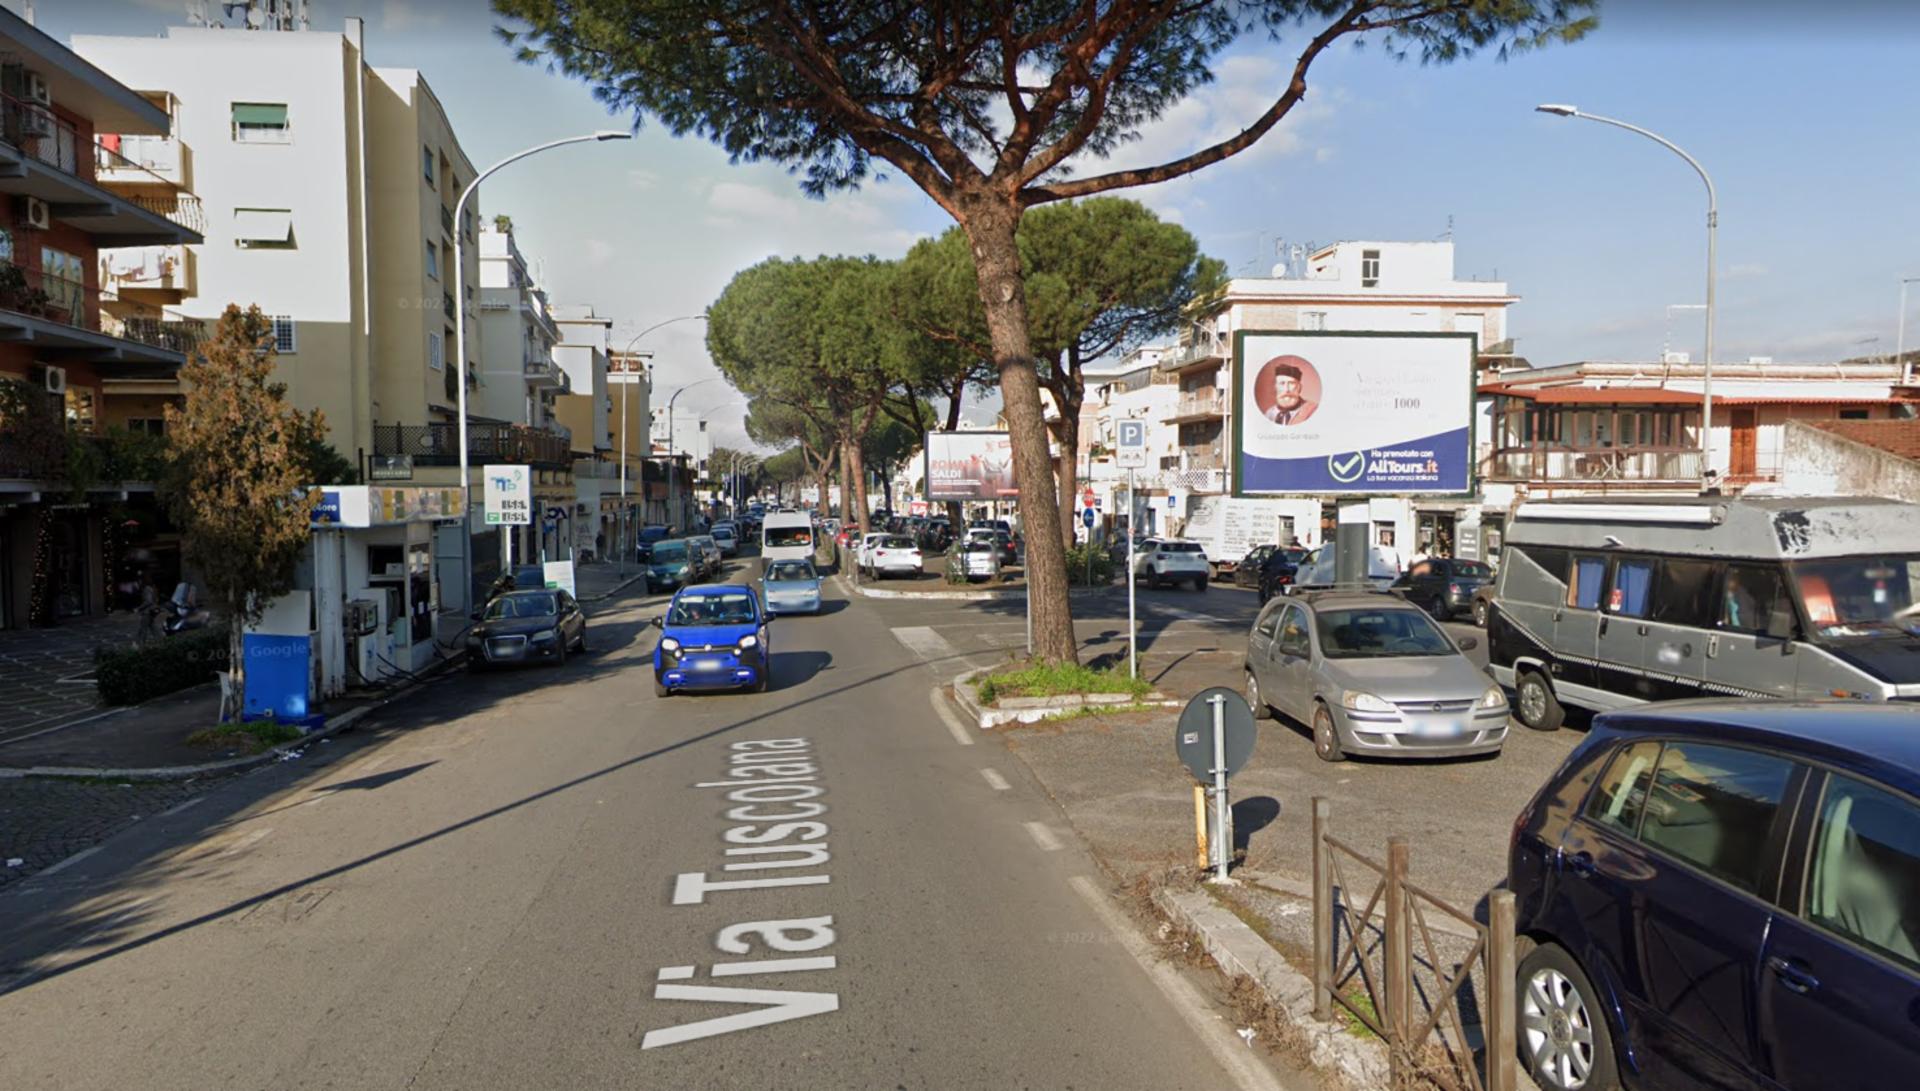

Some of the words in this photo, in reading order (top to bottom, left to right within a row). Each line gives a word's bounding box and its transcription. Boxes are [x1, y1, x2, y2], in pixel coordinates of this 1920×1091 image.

[1394, 397, 1421, 409] 1000
[1125, 426, 1138, 444] P
[1383, 449, 1418, 459] prenotato
[1367, 459, 1439, 474] AllTours.it
